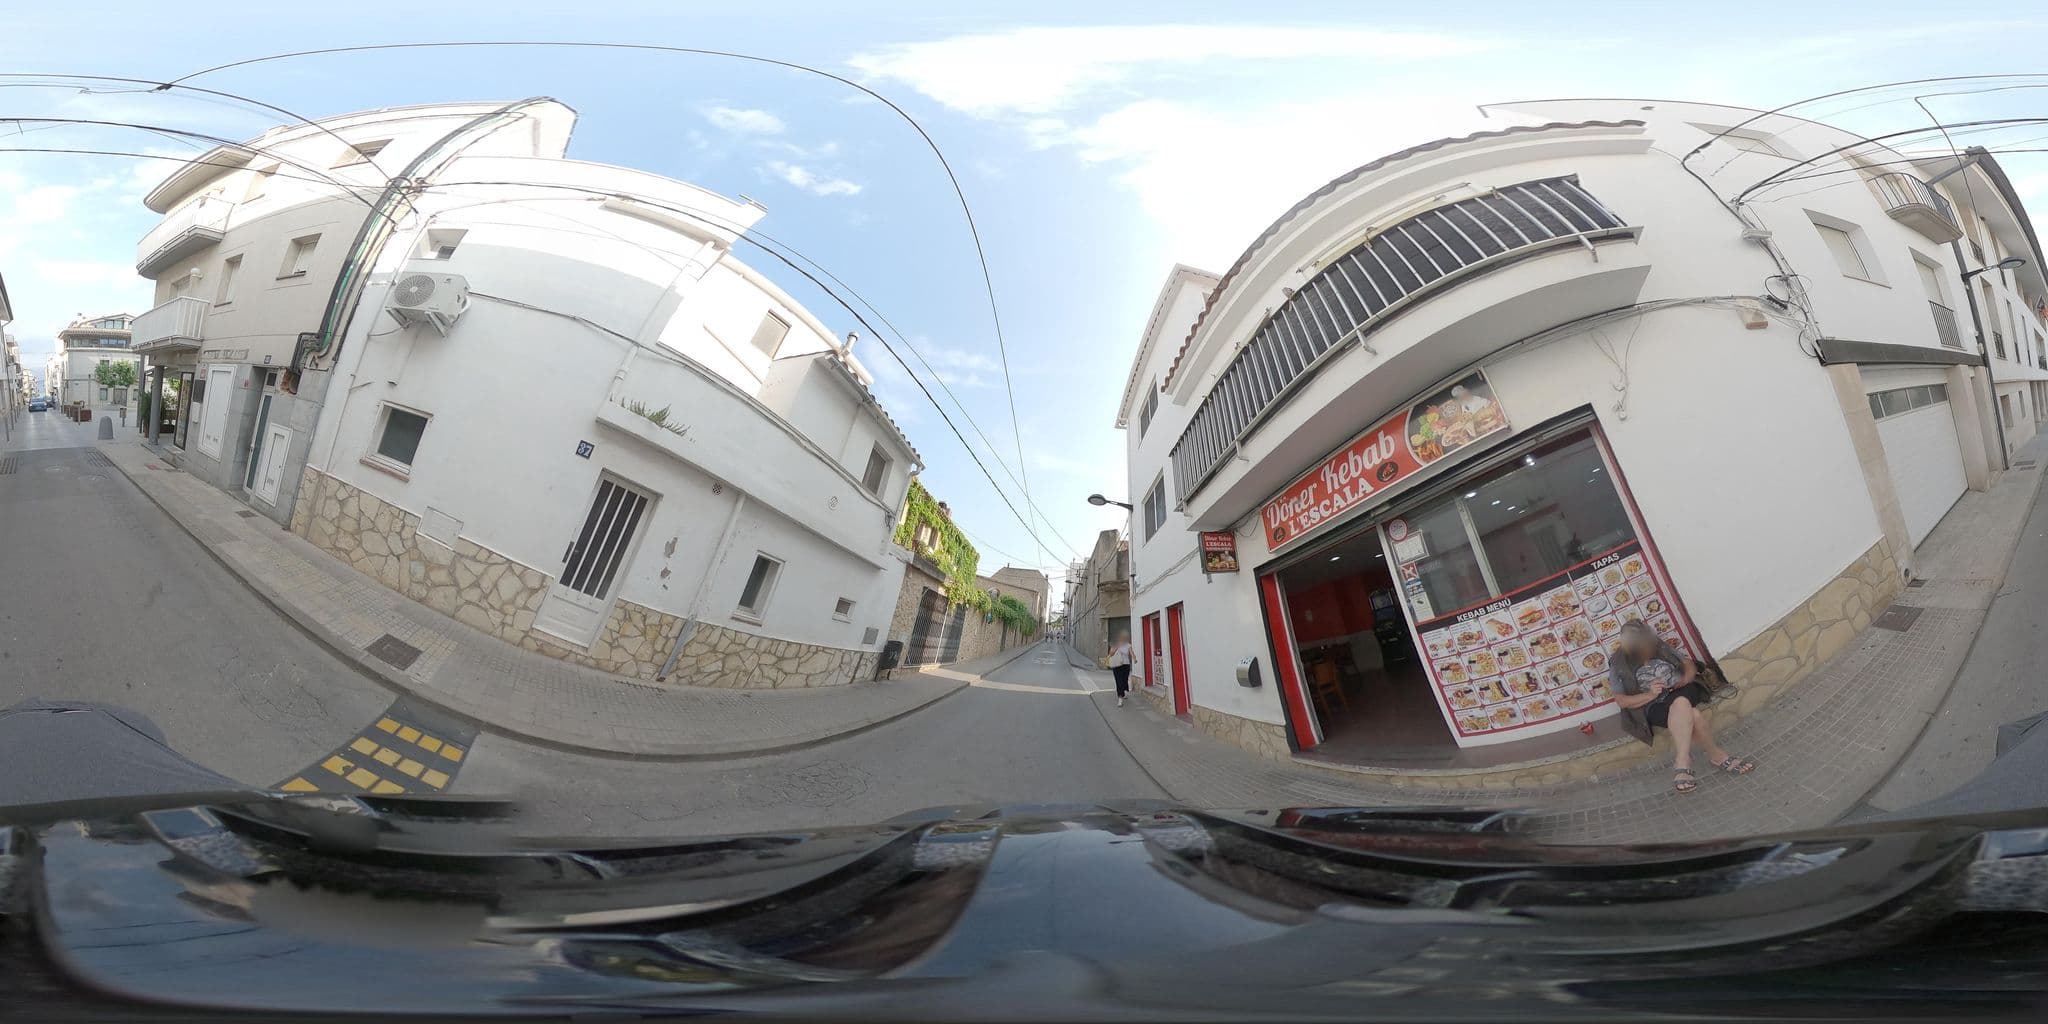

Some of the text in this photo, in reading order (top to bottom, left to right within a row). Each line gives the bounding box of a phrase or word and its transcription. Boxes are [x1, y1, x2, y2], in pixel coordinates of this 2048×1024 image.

[577, 442, 593, 457] 37
[1267, 431, 1395, 528] Döner Kebab
[1288, 478, 1374, 536] L'ESCALA
[1590, 553, 1620, 570] TAPAS
[1456, 608, 1486, 622] KEBAB
